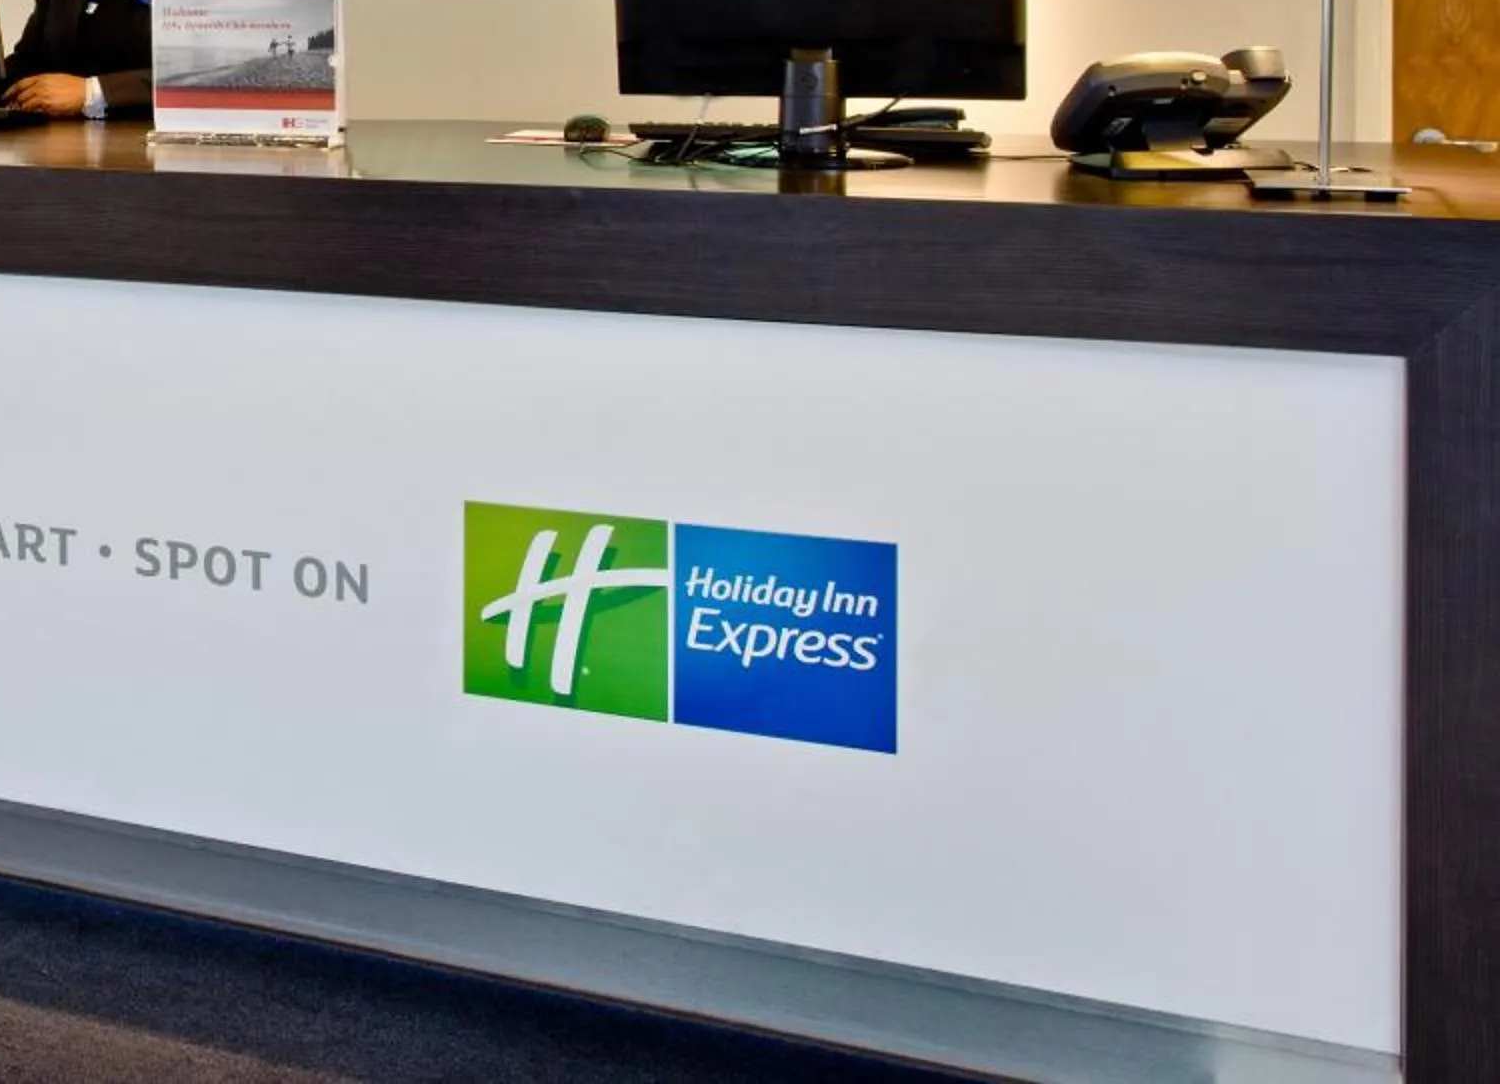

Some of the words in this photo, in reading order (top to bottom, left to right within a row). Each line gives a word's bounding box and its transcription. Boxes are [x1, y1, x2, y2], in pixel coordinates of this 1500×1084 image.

[135, 537, 272, 591] SPOT
[293, 556, 369, 605] ON
[685, 565, 818, 618] Holiday
[822, 580, 879, 618] Inn
[686, 606, 879, 671] Express
